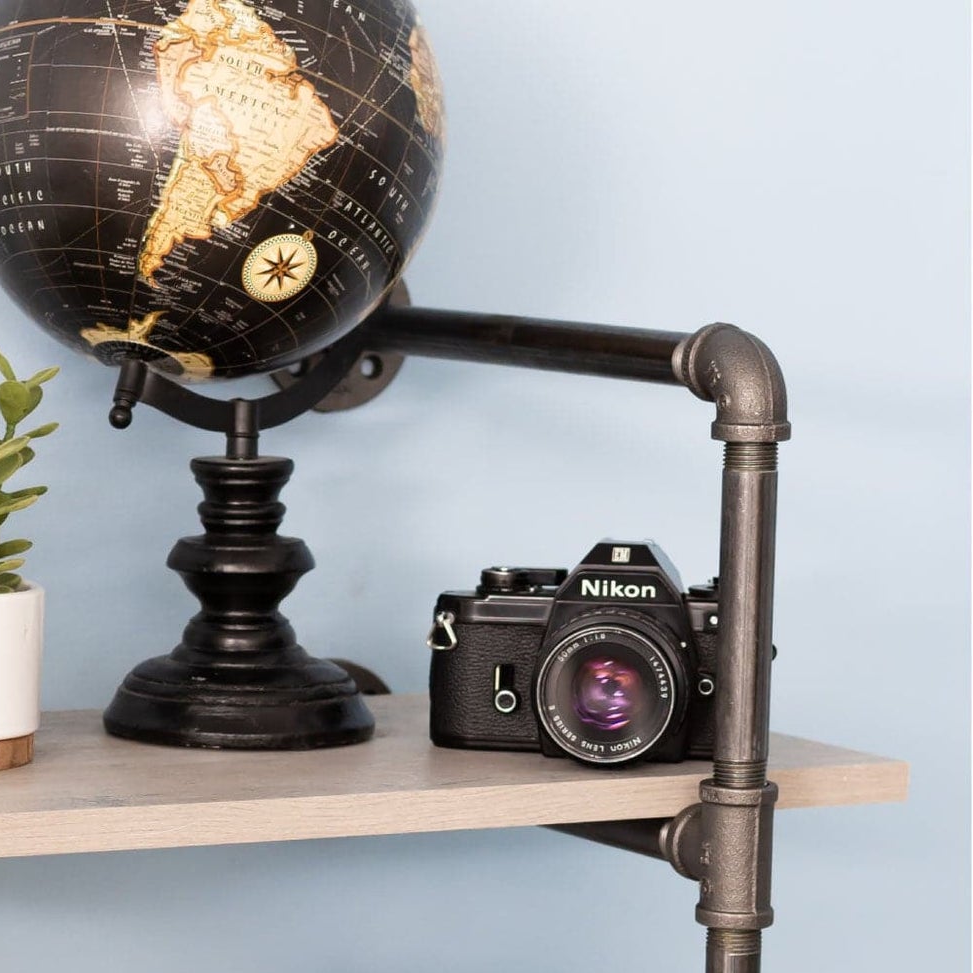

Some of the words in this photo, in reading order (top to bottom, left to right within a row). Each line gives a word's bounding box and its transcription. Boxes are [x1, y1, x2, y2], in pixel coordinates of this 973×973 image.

[219, 54, 263, 75] SOUTH
[204, 83, 282, 116] AMERICA
[368, 169, 409, 211] SOUTH
[0, 219, 45, 236] OCEAN
[344, 201, 395, 254] ATLANTIC
[327, 230, 371, 270] OCEAN
[581, 579, 657, 599] Nikon
[557, 642, 580, 662] 50mm
[552, 714, 578, 742] SERIES
[580, 740, 604, 753] LENS
[609, 736, 642, 752] Nikon
